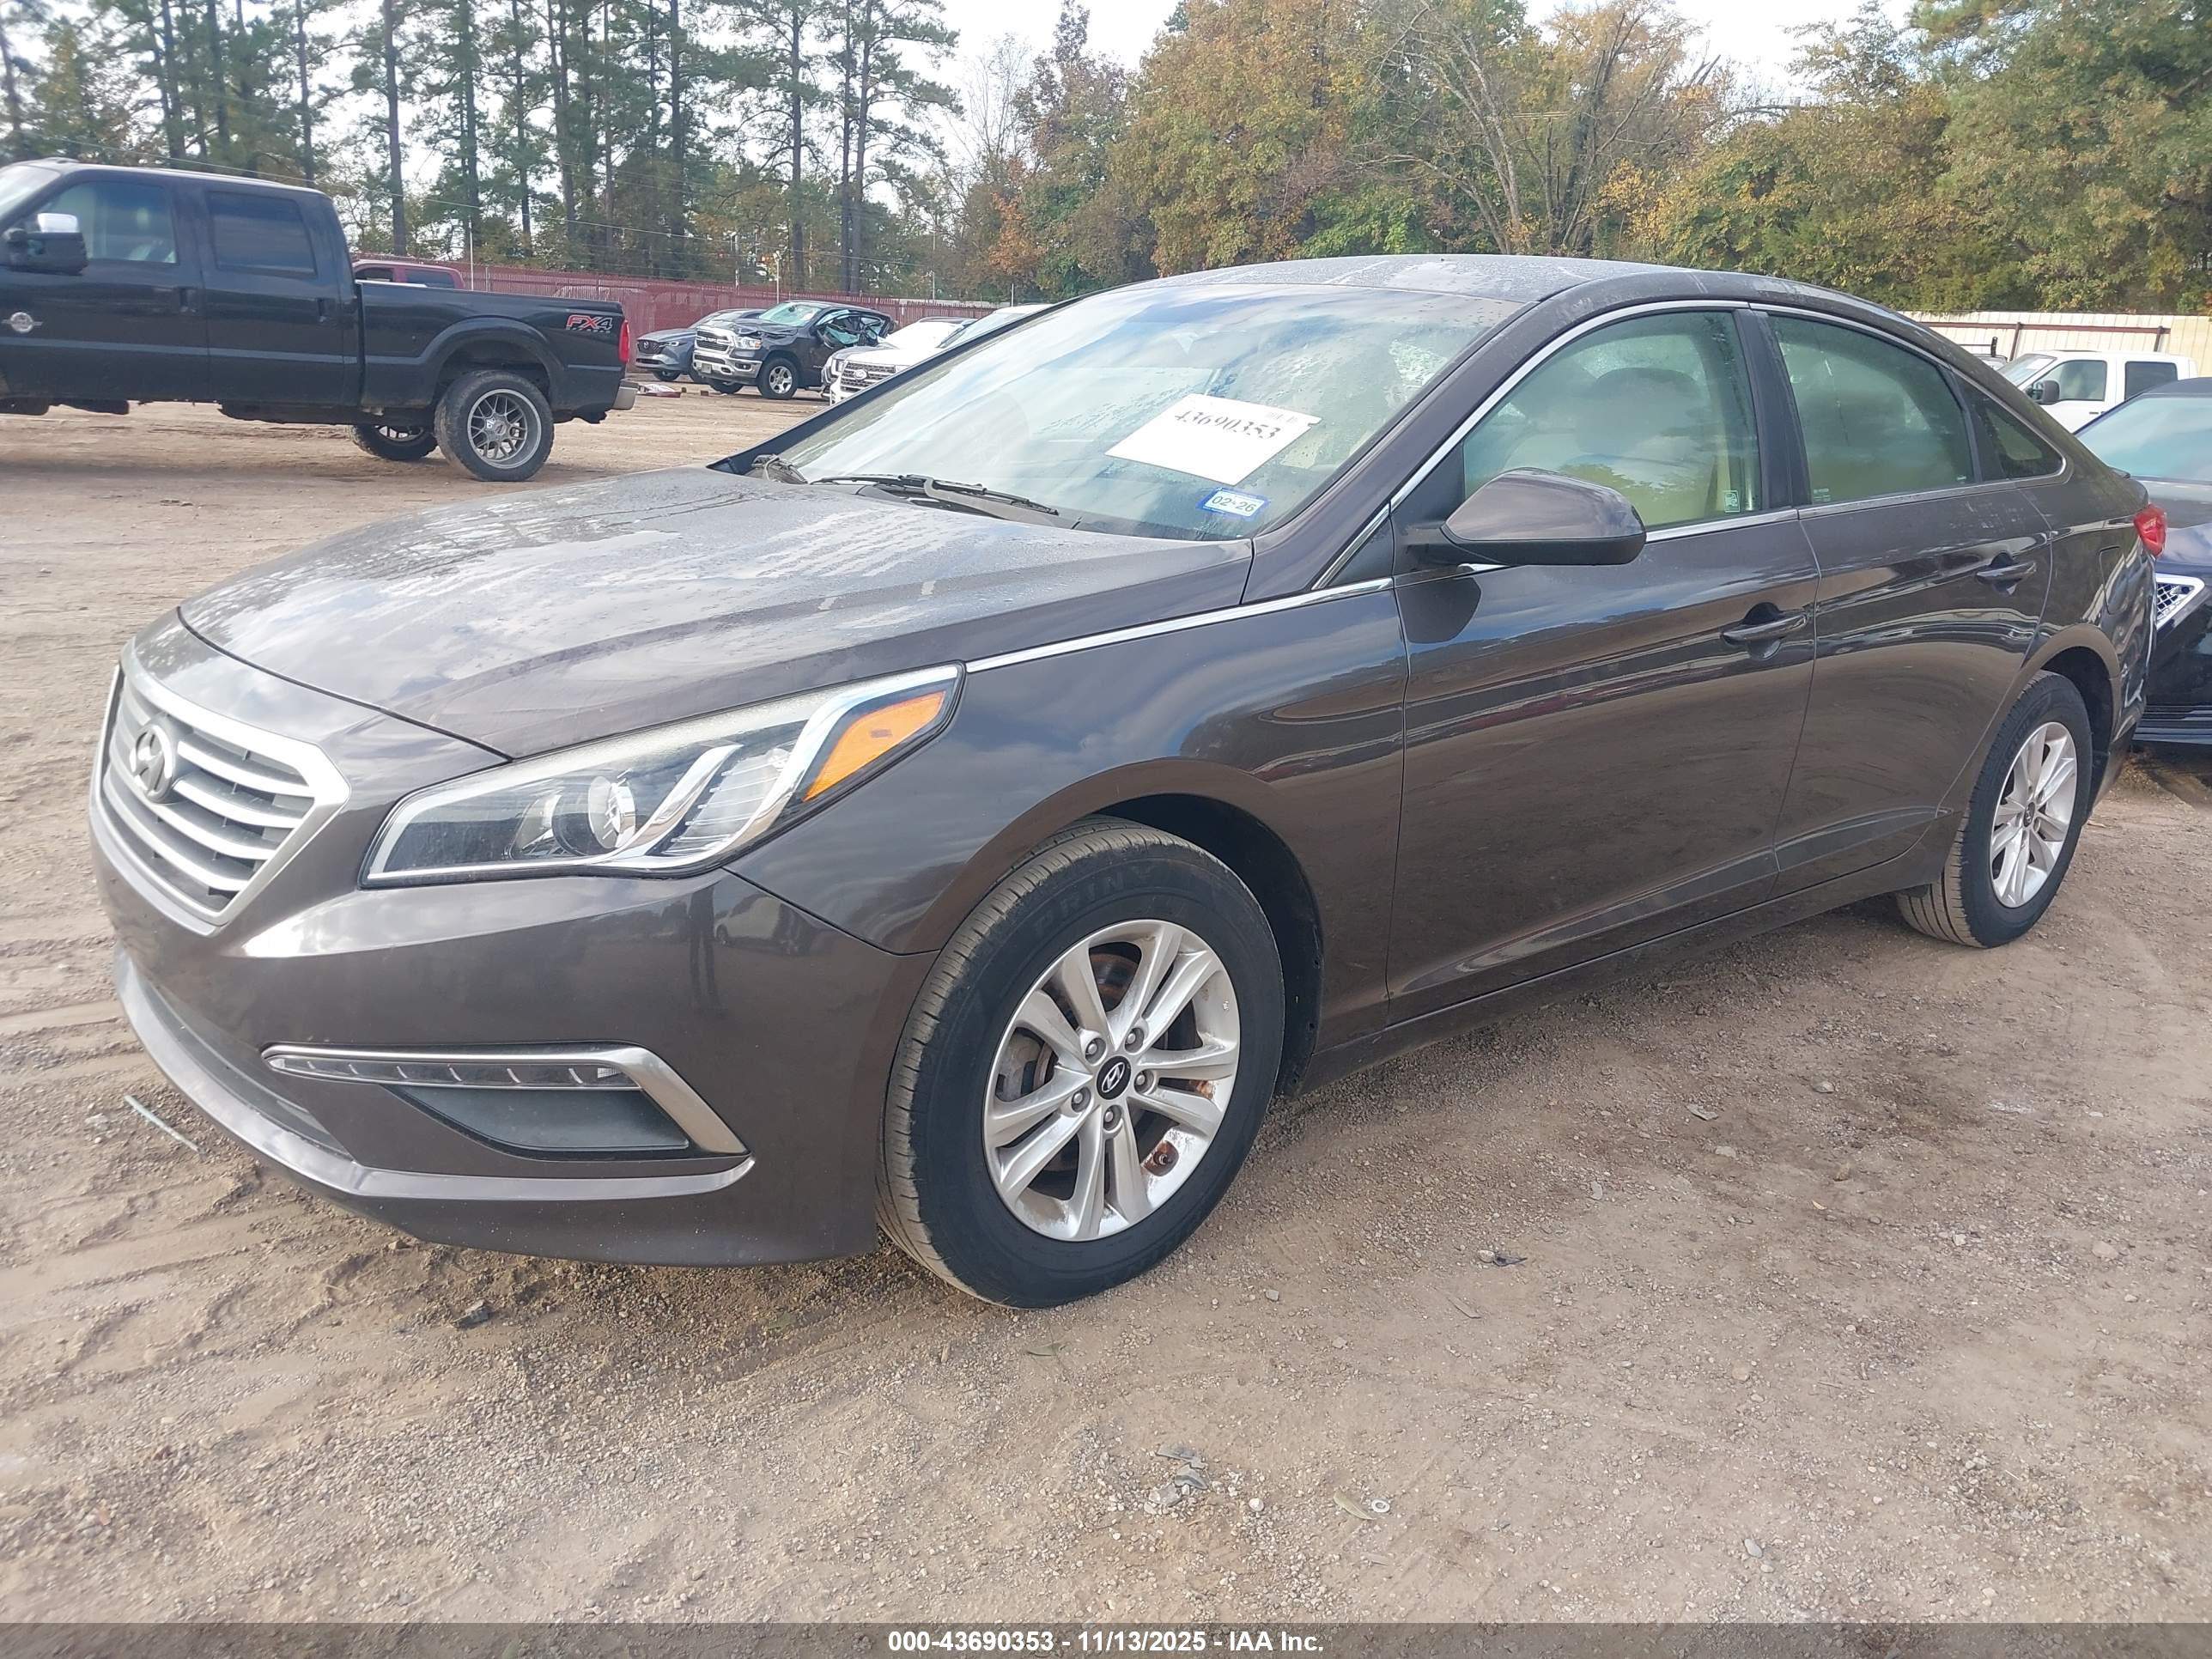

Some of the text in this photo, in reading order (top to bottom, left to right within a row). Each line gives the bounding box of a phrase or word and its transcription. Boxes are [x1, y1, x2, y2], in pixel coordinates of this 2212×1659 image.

[566, 314, 613, 330] FX4
[1174, 410, 1281, 440] 43690353
[1212, 495, 1257, 513] 02-26
